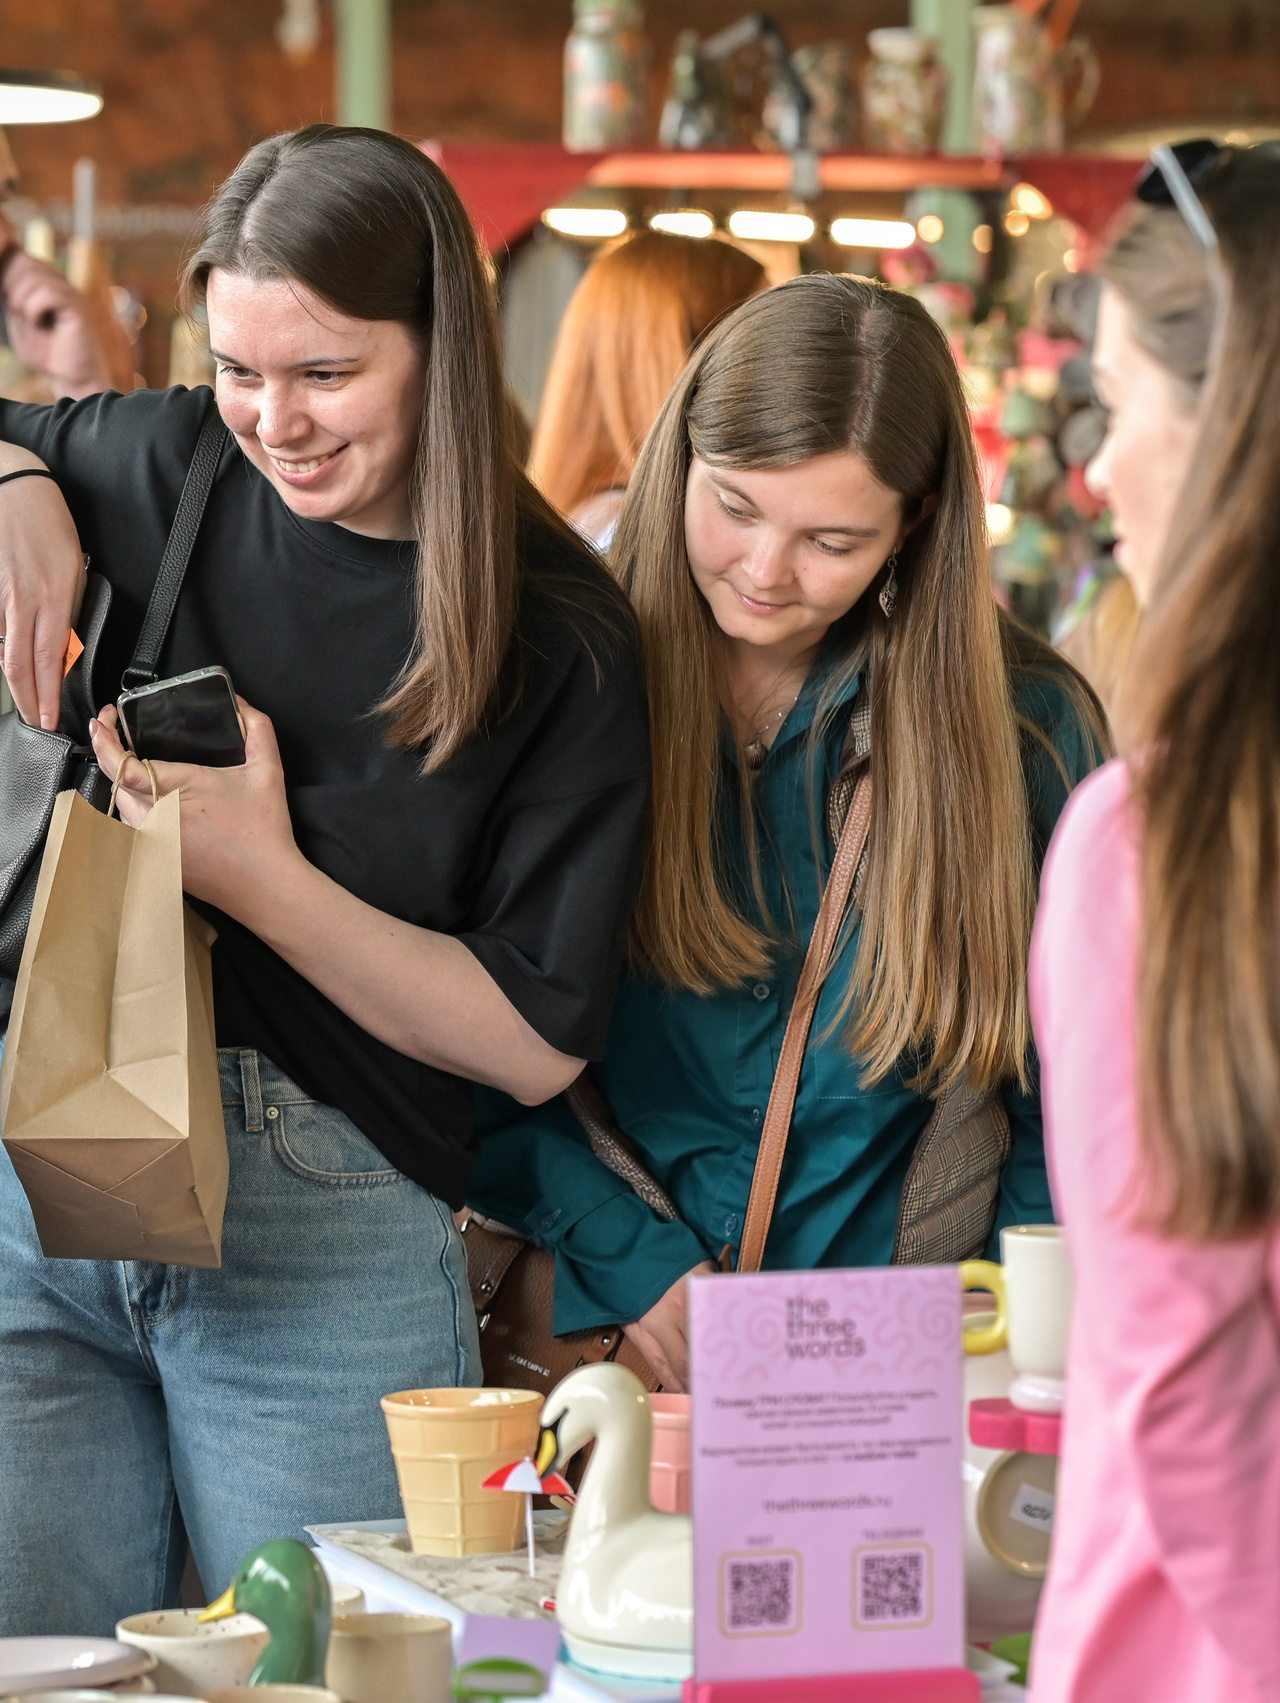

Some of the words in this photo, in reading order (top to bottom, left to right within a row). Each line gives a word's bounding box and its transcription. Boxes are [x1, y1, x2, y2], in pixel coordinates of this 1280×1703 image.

[786, 1294, 831, 1320] the
[786, 1314, 856, 1340] three
[785, 1334, 867, 1361] words
